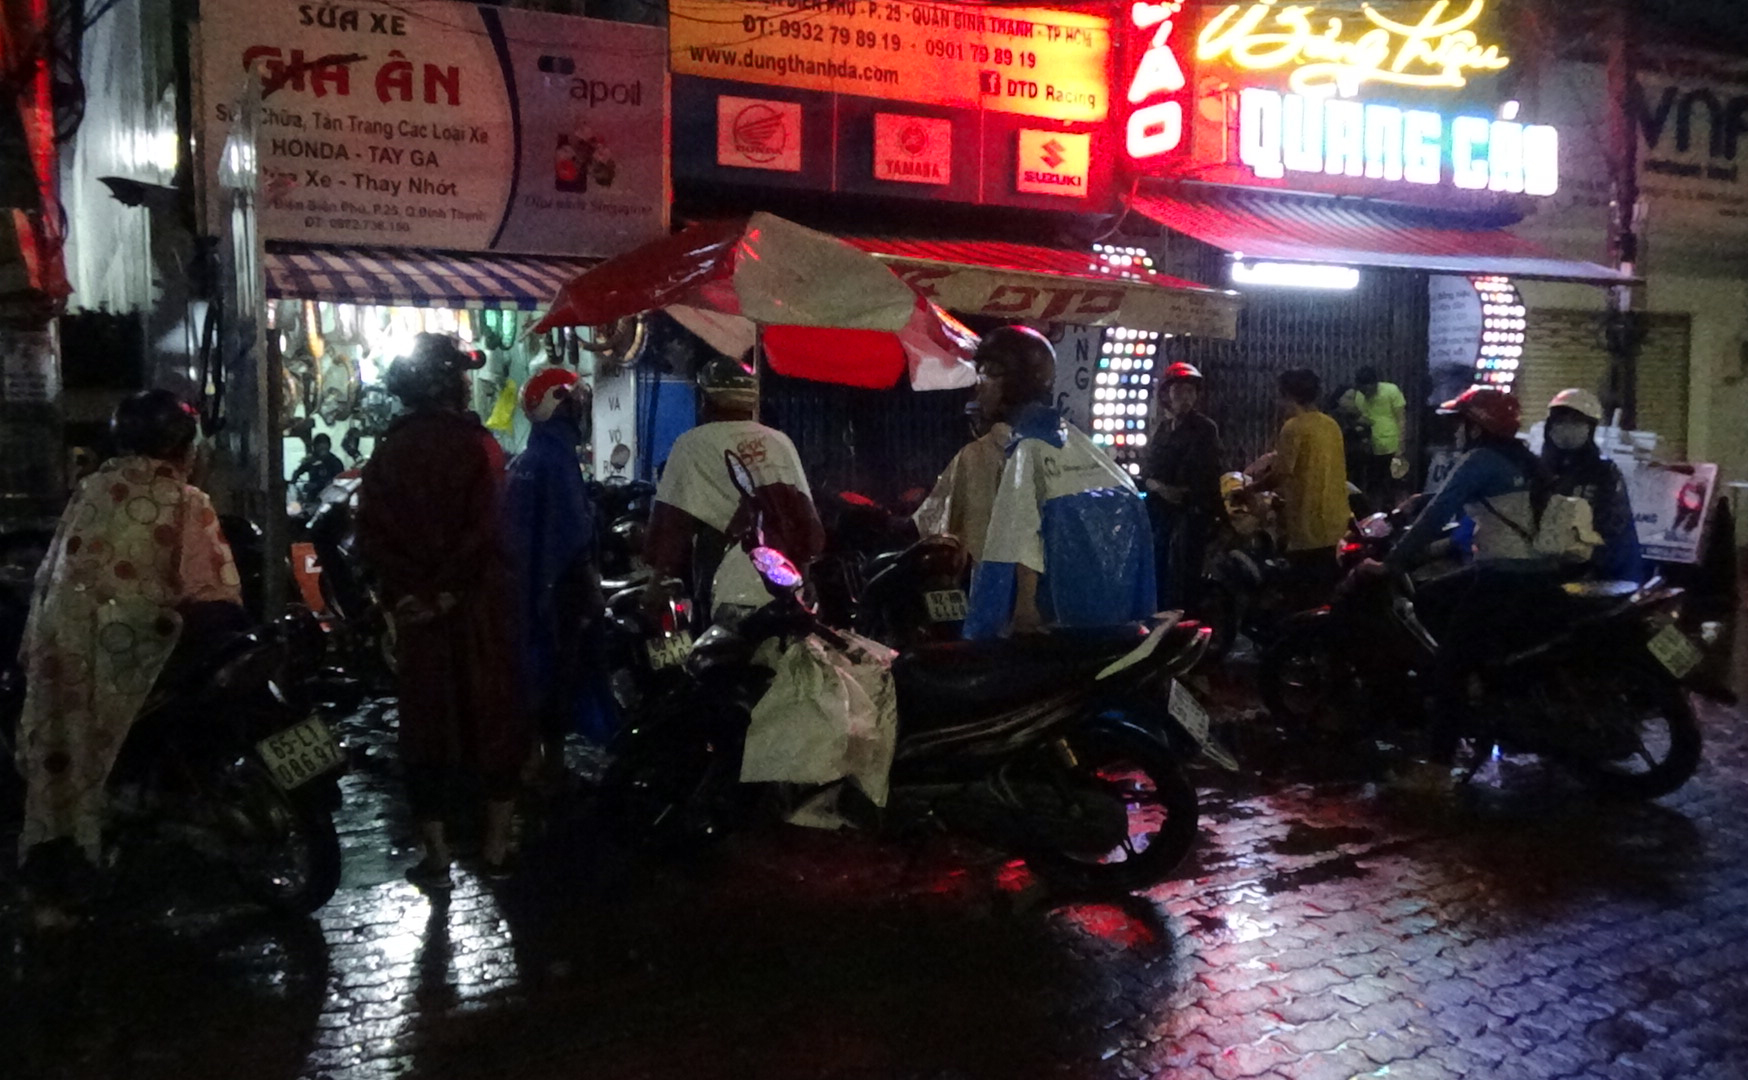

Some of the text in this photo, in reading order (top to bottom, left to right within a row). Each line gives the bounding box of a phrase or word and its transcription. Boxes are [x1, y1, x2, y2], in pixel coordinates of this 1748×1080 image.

[371, 12, 407, 36] XE
[885, 3, 901, 22] 25
[779, 19, 824, 42] 0932
[829, 26, 851, 45] 79
[855, 29, 877, 49] 89
[881, 32, 901, 52] 19
[925, 39, 964, 61] 0901
[969, 43, 989, 63] 79
[993, 47, 1013, 66] 89
[1018, 51, 1037, 69] 19
[374, 49, 461, 106] ÂN
[689, 44, 899, 85] www.dungthanhda.com
[1007, 80, 1038, 99] DTD
[1045, 85, 1096, 109] Racing
[348, 115, 394, 140] Trang
[469, 126, 489, 143] Xe
[272, 139, 440, 168] HONDA TAY GA
[305, 170, 332, 188] Xe
[353, 173, 401, 196] Thay
[1023, 170, 1082, 187] SUZUKI
